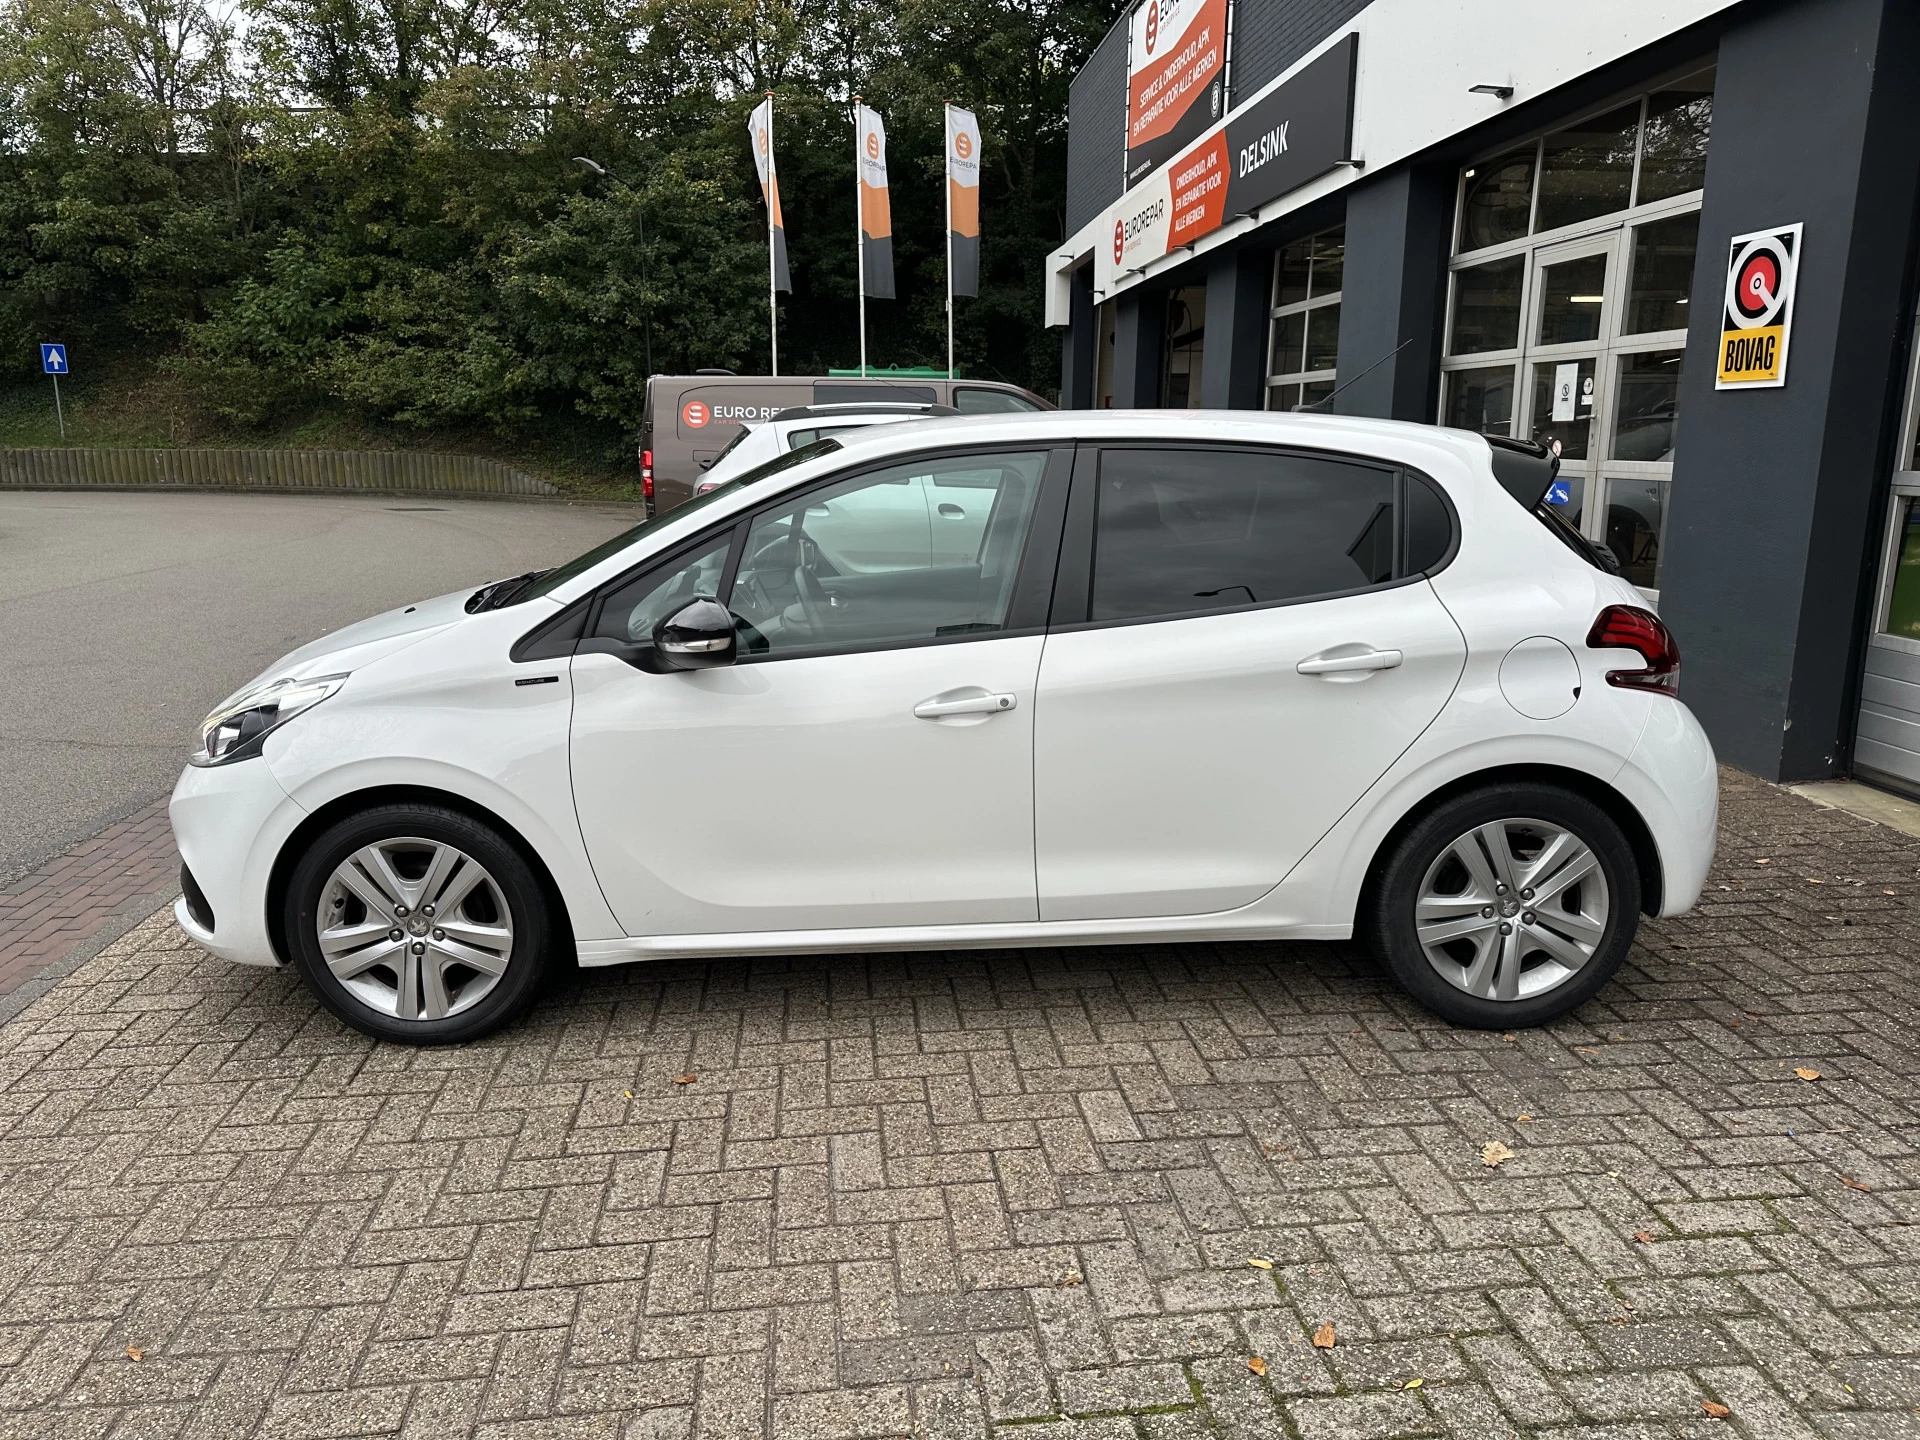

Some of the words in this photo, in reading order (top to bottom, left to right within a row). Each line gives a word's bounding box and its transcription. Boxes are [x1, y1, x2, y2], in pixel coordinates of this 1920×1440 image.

[1140, 78, 1158, 109] SERVICE
[1197, 26, 1210, 52] APK
[1134, 119, 1140, 137] EN
[1140, 97, 1163, 131] REPARATIE
[1163, 83, 1178, 109] VOOR
[1179, 69, 1192, 96] ALLE
[1193, 46, 1217, 82] MERKEN
[1207, 150, 1217, 170] APK
[1240, 120, 1289, 178] DELSINK
[1176, 197, 1182, 212] EN
[1182, 180, 1206, 207] REPARATIE
[1206, 170, 1221, 192] VOOR
[1125, 198, 1163, 241] EUROREPAR
[1175, 214, 1185, 232] ALLE
[1185, 204, 1205, 227] MERKEN
[1724, 335, 1776, 372] BOVAG
[714, 406, 757, 419] EURO
[761, 407, 785, 419] RE
